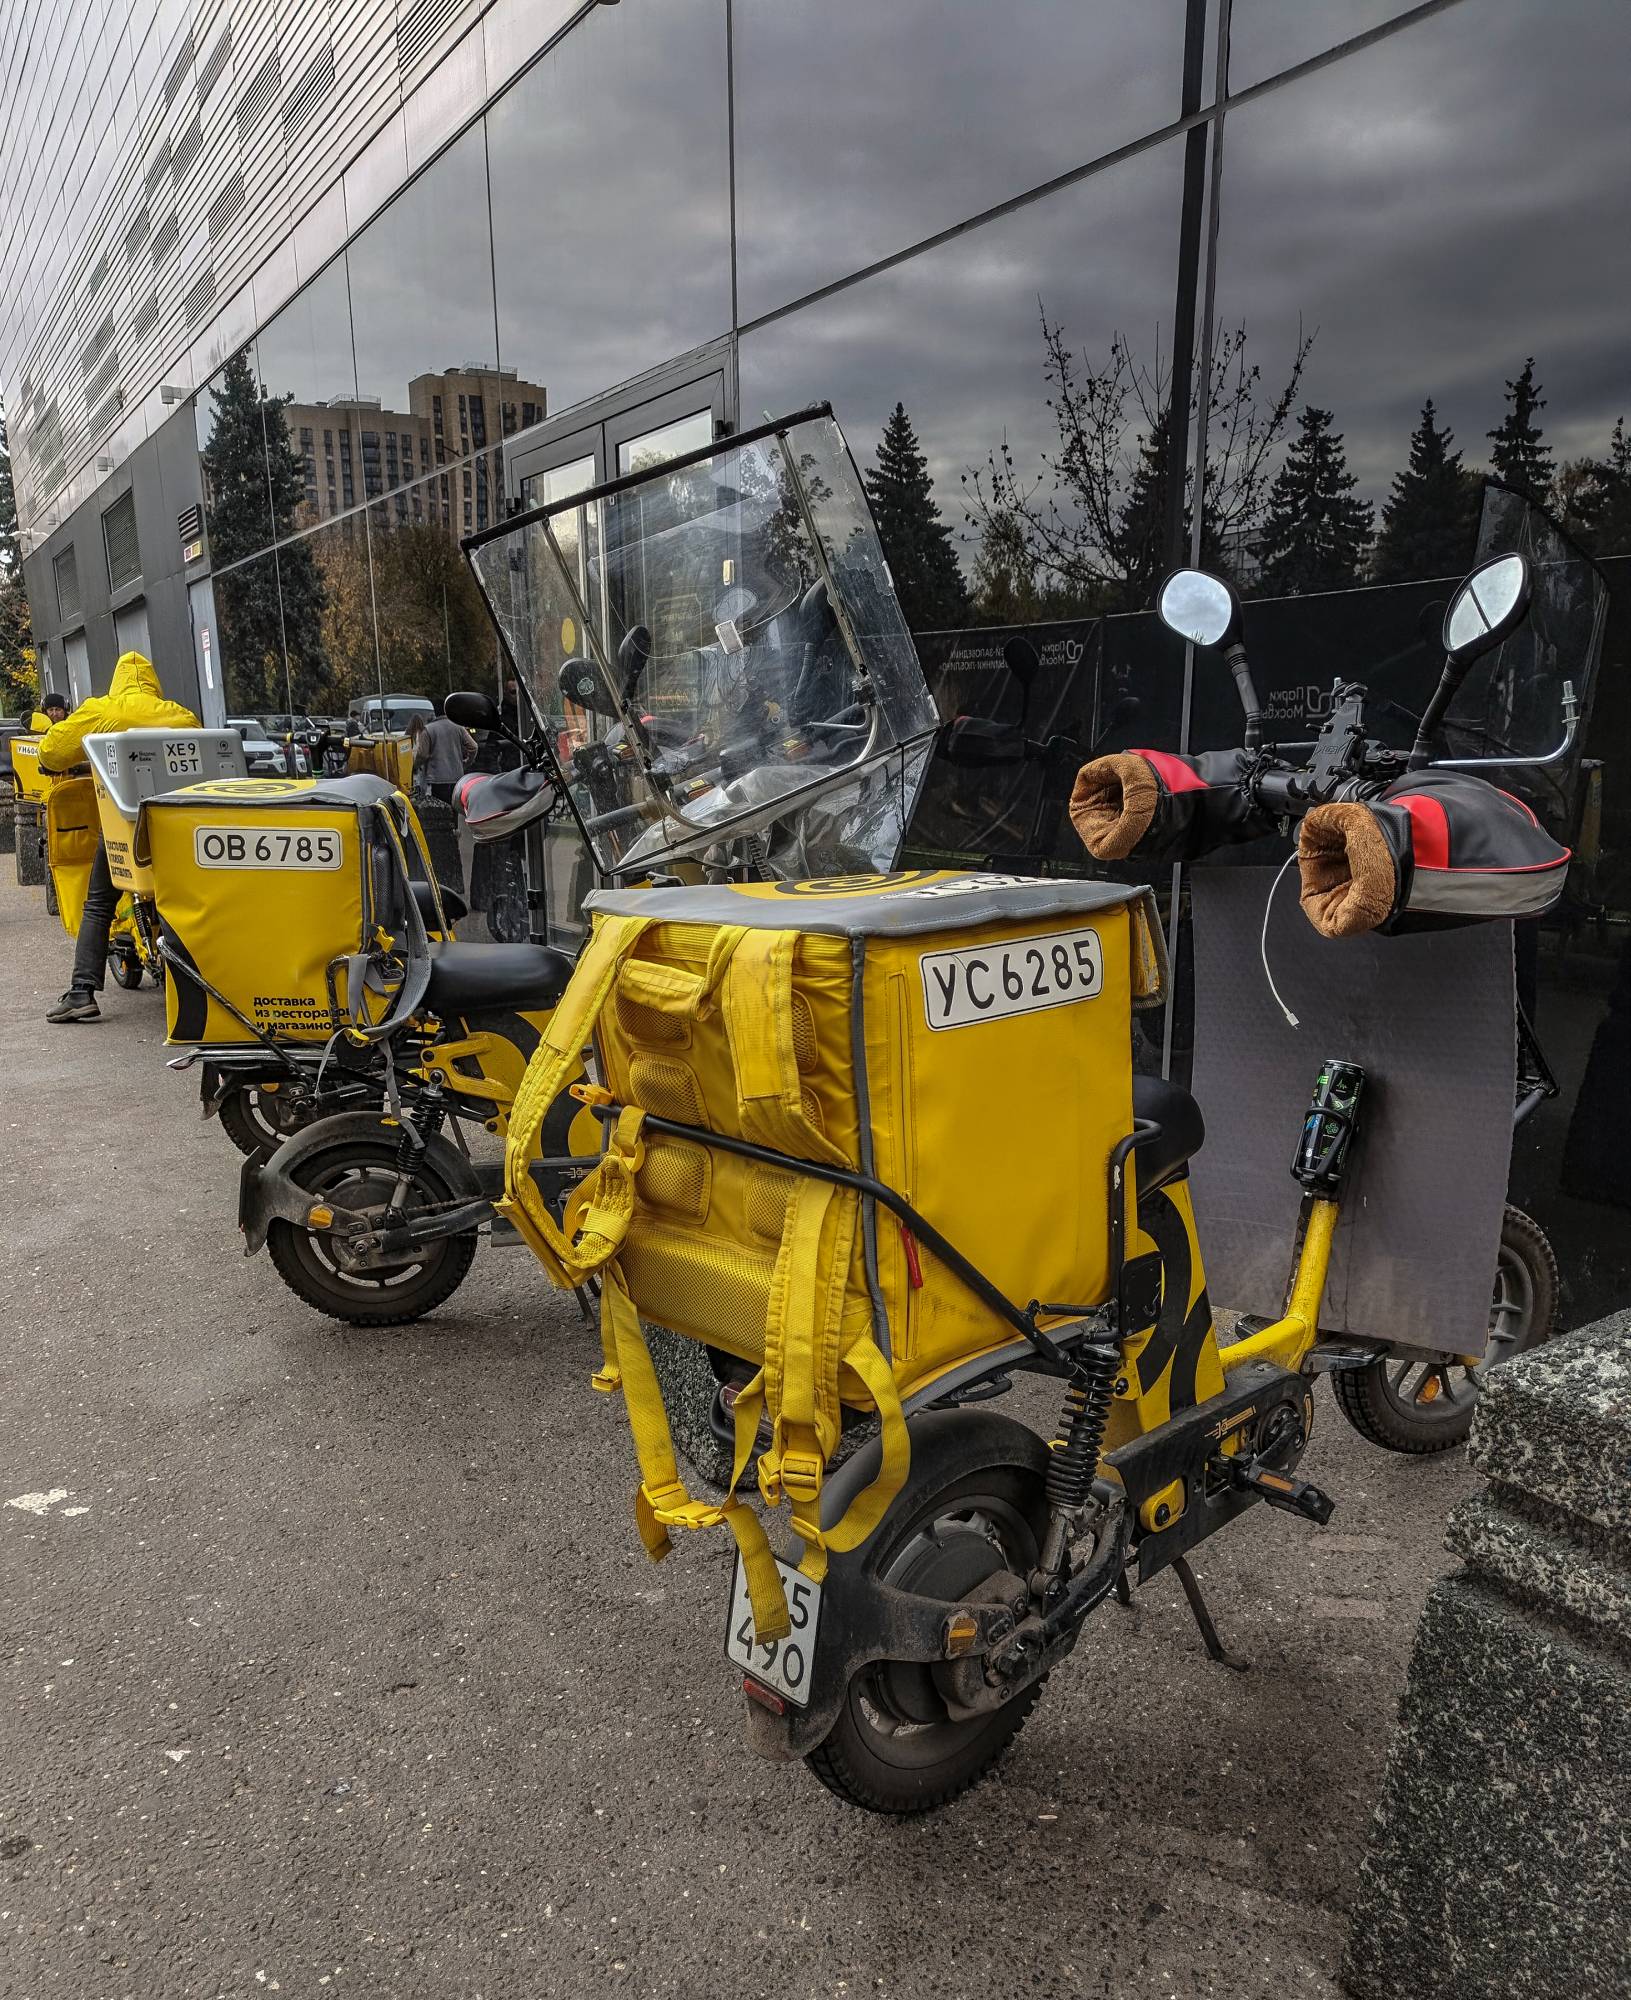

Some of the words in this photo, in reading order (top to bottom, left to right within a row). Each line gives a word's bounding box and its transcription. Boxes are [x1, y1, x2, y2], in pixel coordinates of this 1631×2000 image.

[255, 835, 334, 863] 6785
[253, 997, 316, 1007] доставка
[255, 1009, 271, 1018] из
[256, 1021, 265, 1031] и
[268, 1020, 333, 1031] магазино
